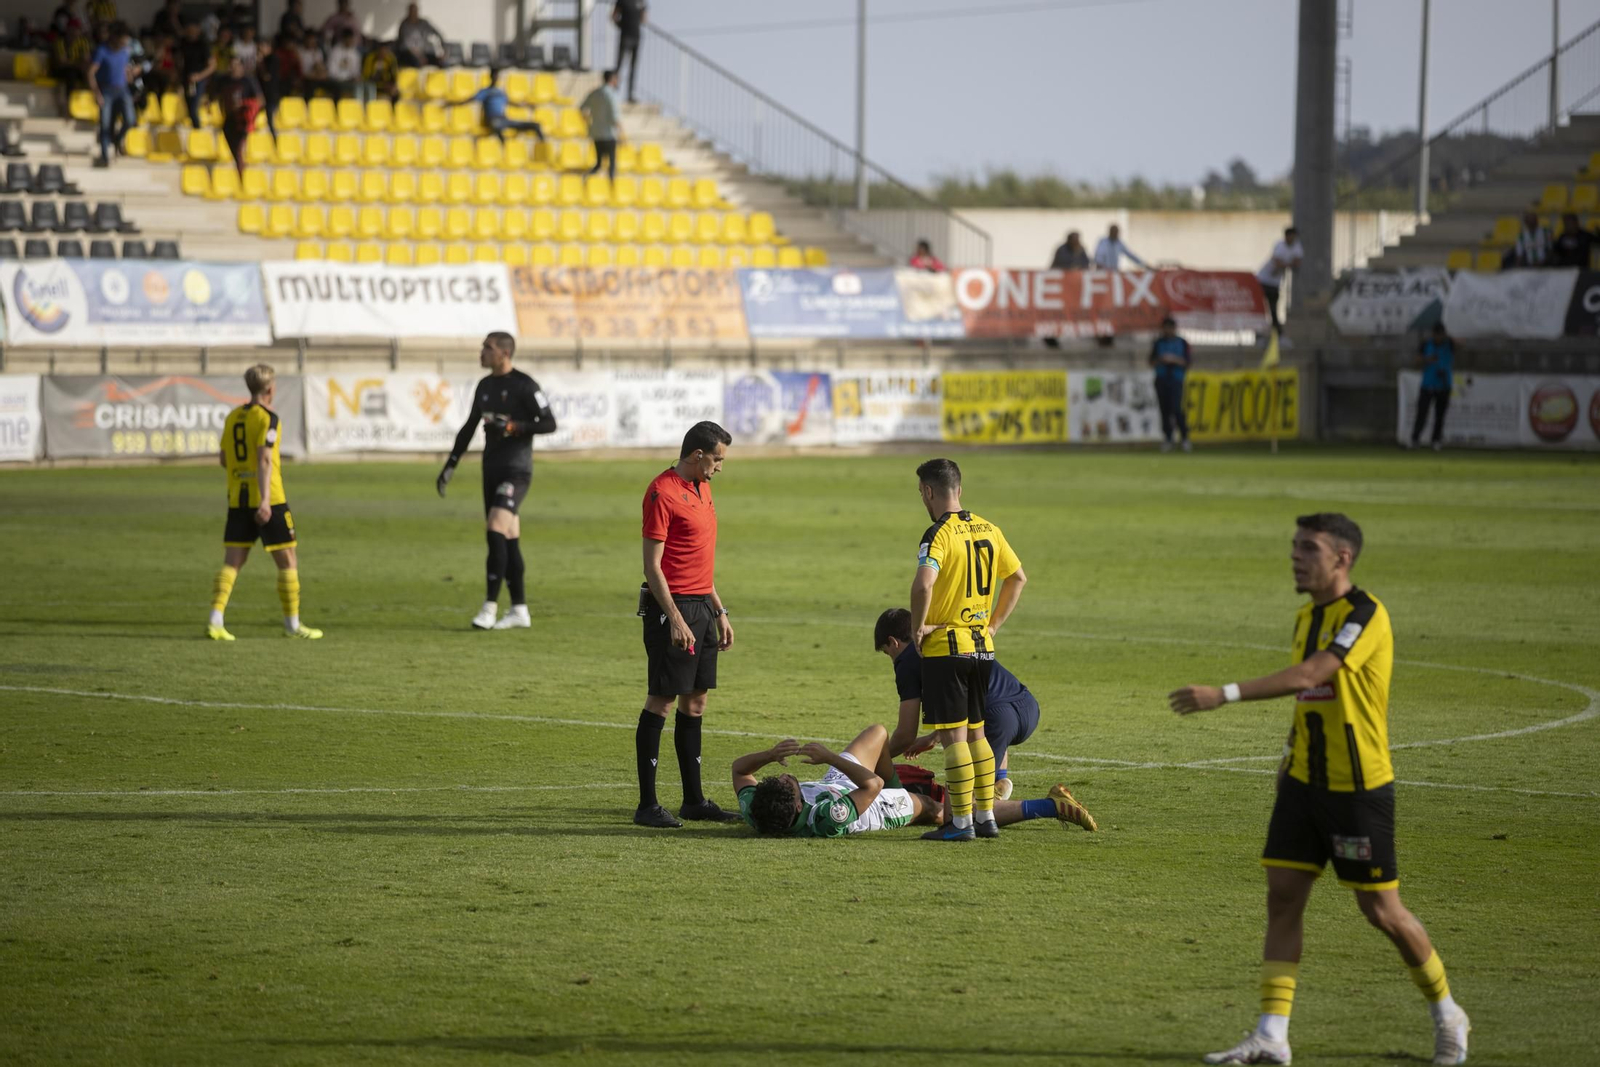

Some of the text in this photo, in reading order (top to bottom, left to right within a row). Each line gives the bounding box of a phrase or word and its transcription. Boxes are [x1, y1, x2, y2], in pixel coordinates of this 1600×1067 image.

[956, 268, 1065, 311] ONE
[1080, 269, 1159, 309] FIX
[1186, 378, 1296, 433] EL PICOTE
[233, 422, 247, 462] 8
[964, 538, 994, 598] 10
